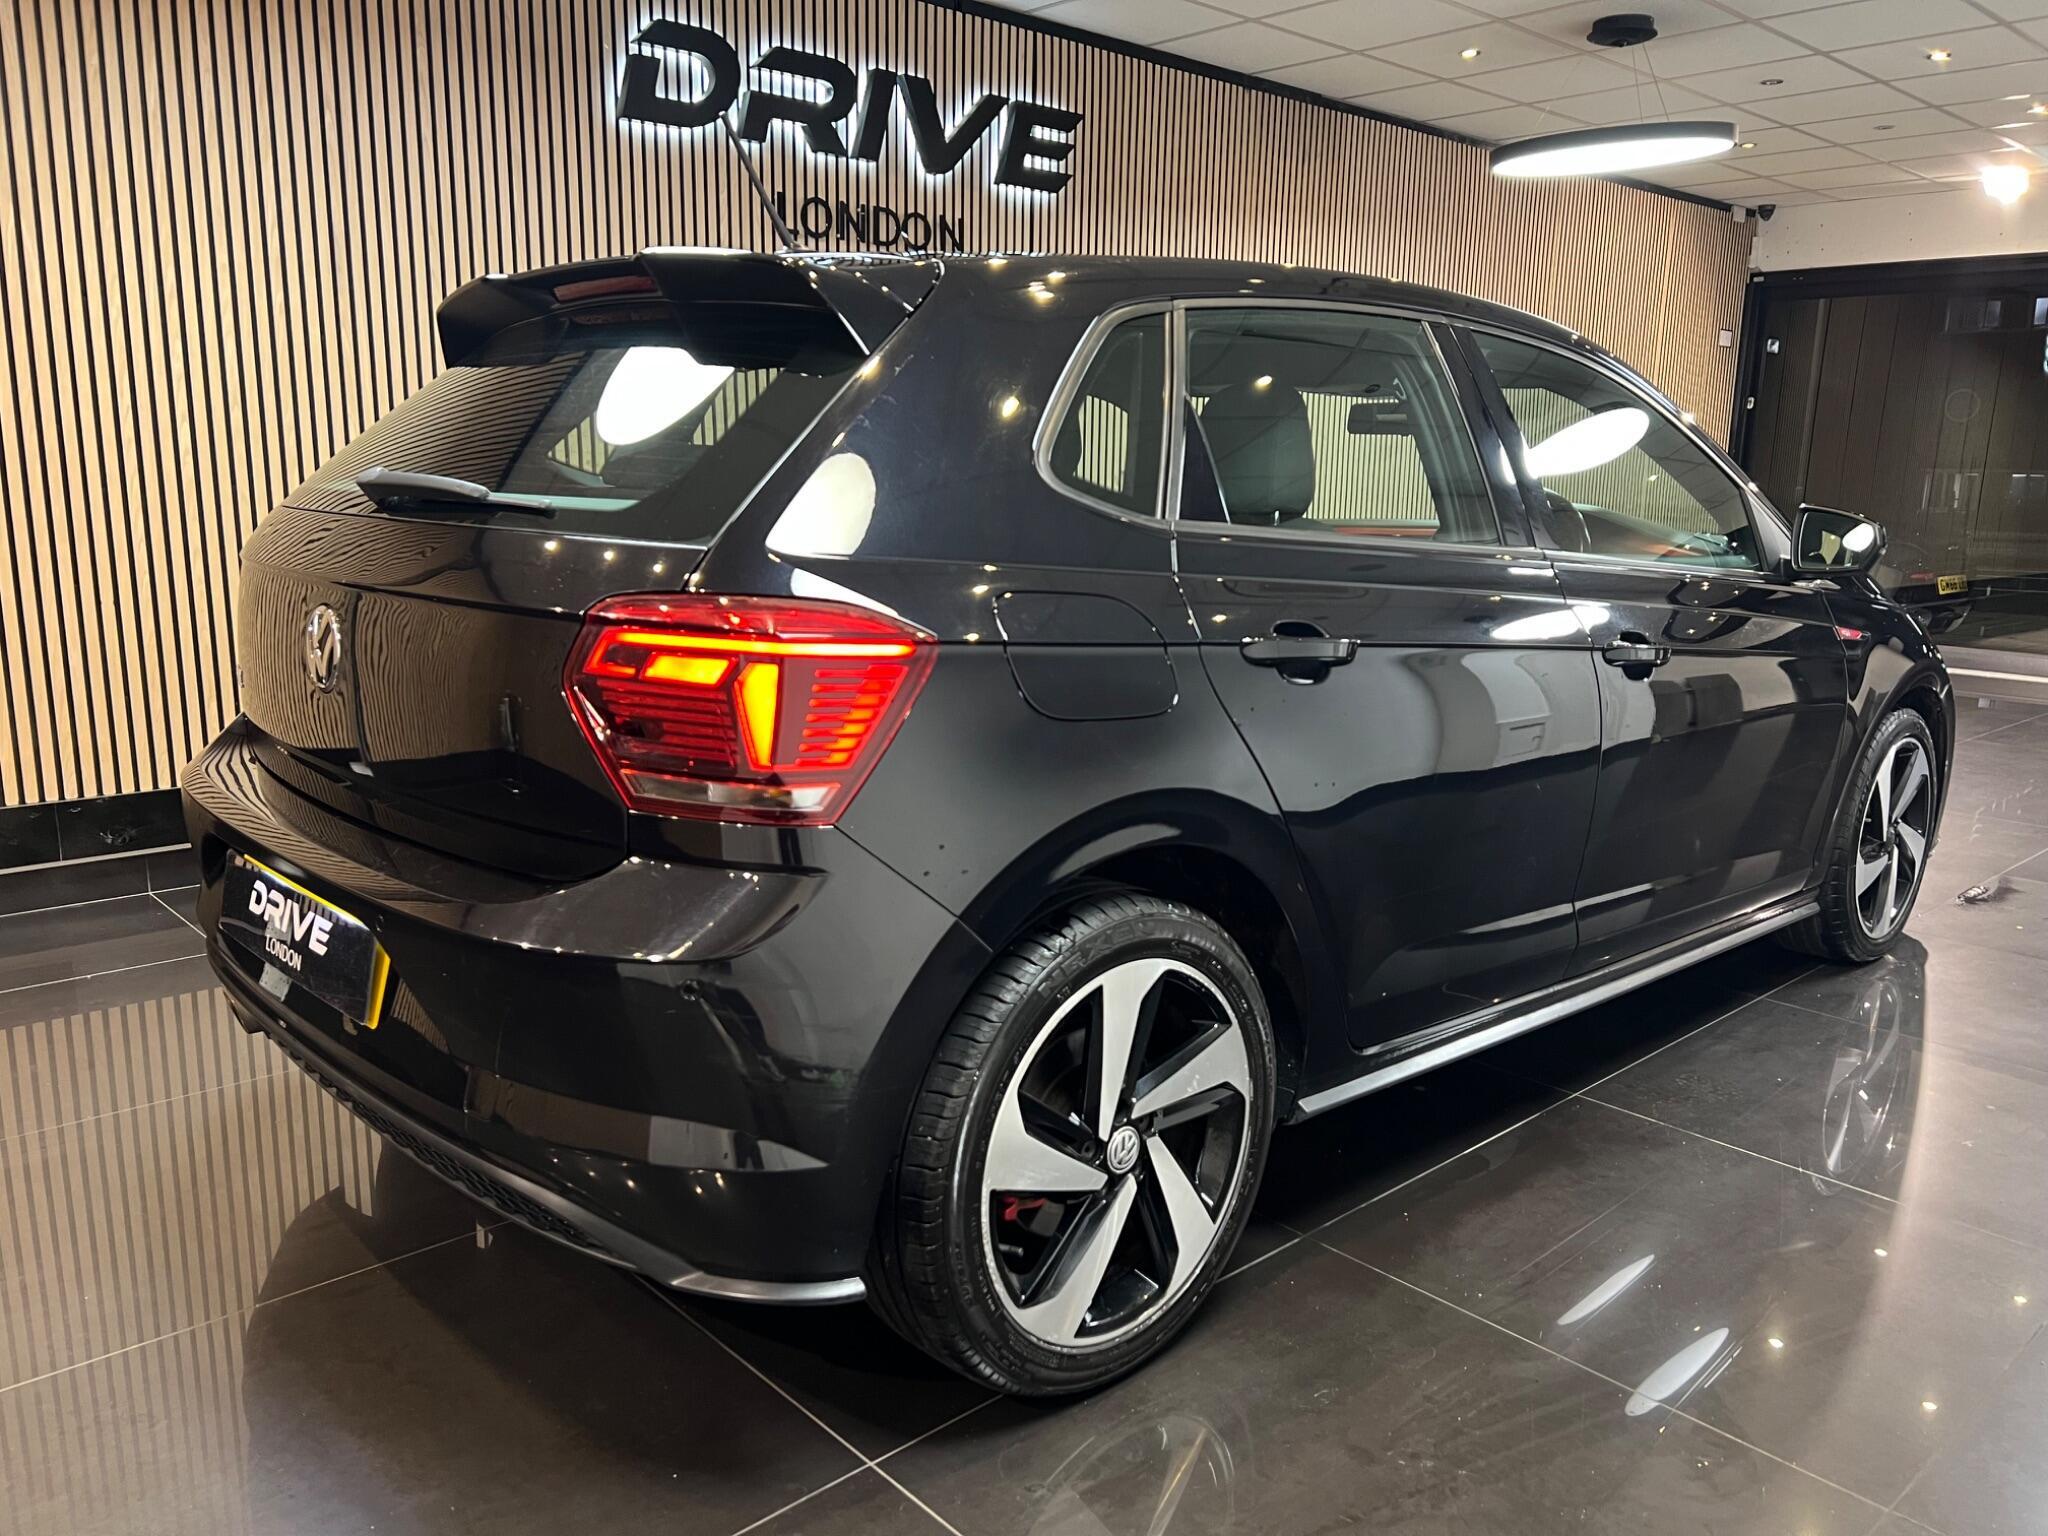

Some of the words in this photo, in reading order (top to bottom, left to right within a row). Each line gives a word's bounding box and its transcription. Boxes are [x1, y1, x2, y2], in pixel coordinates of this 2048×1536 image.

[617, 18, 1084, 194] DRIVE
[777, 191, 964, 252] LONDON
[249, 880, 334, 956] DRIVE
[265, 935, 303, 971] LONDON
